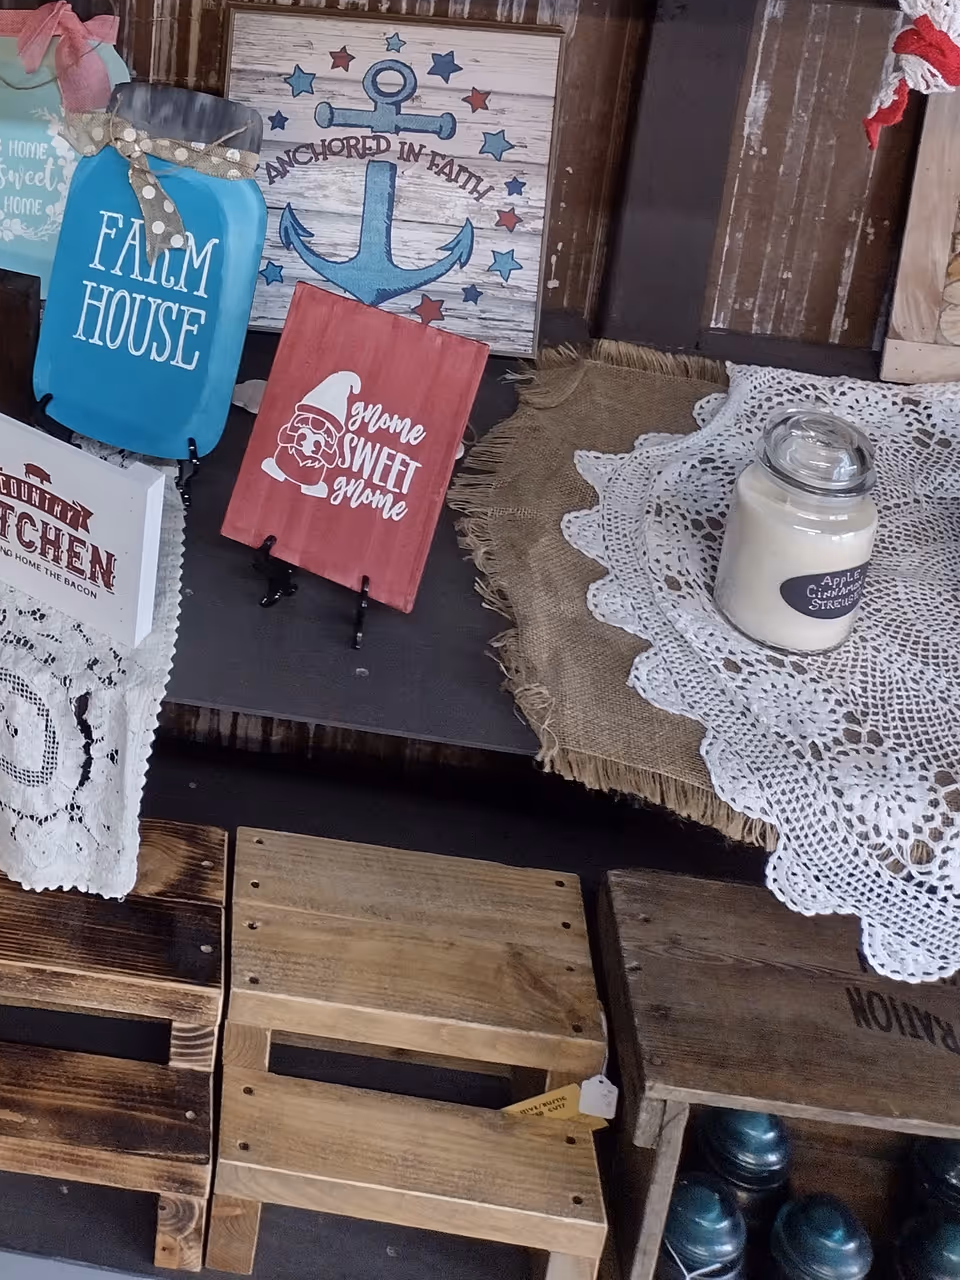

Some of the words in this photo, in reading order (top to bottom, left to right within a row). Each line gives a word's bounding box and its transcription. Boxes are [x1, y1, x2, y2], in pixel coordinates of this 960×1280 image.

[9, 139, 48, 160] HOME
[265, 135, 392, 185] ANCHORED
[397, 141, 426, 162] IN
[427, 150, 495, 202] FAITH
[4, 195, 42, 215] HOME
[73, 280, 207, 371] HOUSE
[348, 401, 427, 446] gnome
[337, 432, 423, 495] SWEET
[0, 475, 74, 524] COUNTRY
[330, 476, 408, 521] gnome
[15, 554, 42, 572] HOME
[44, 568, 62, 582] THE
[64, 577, 98, 600] BACON
